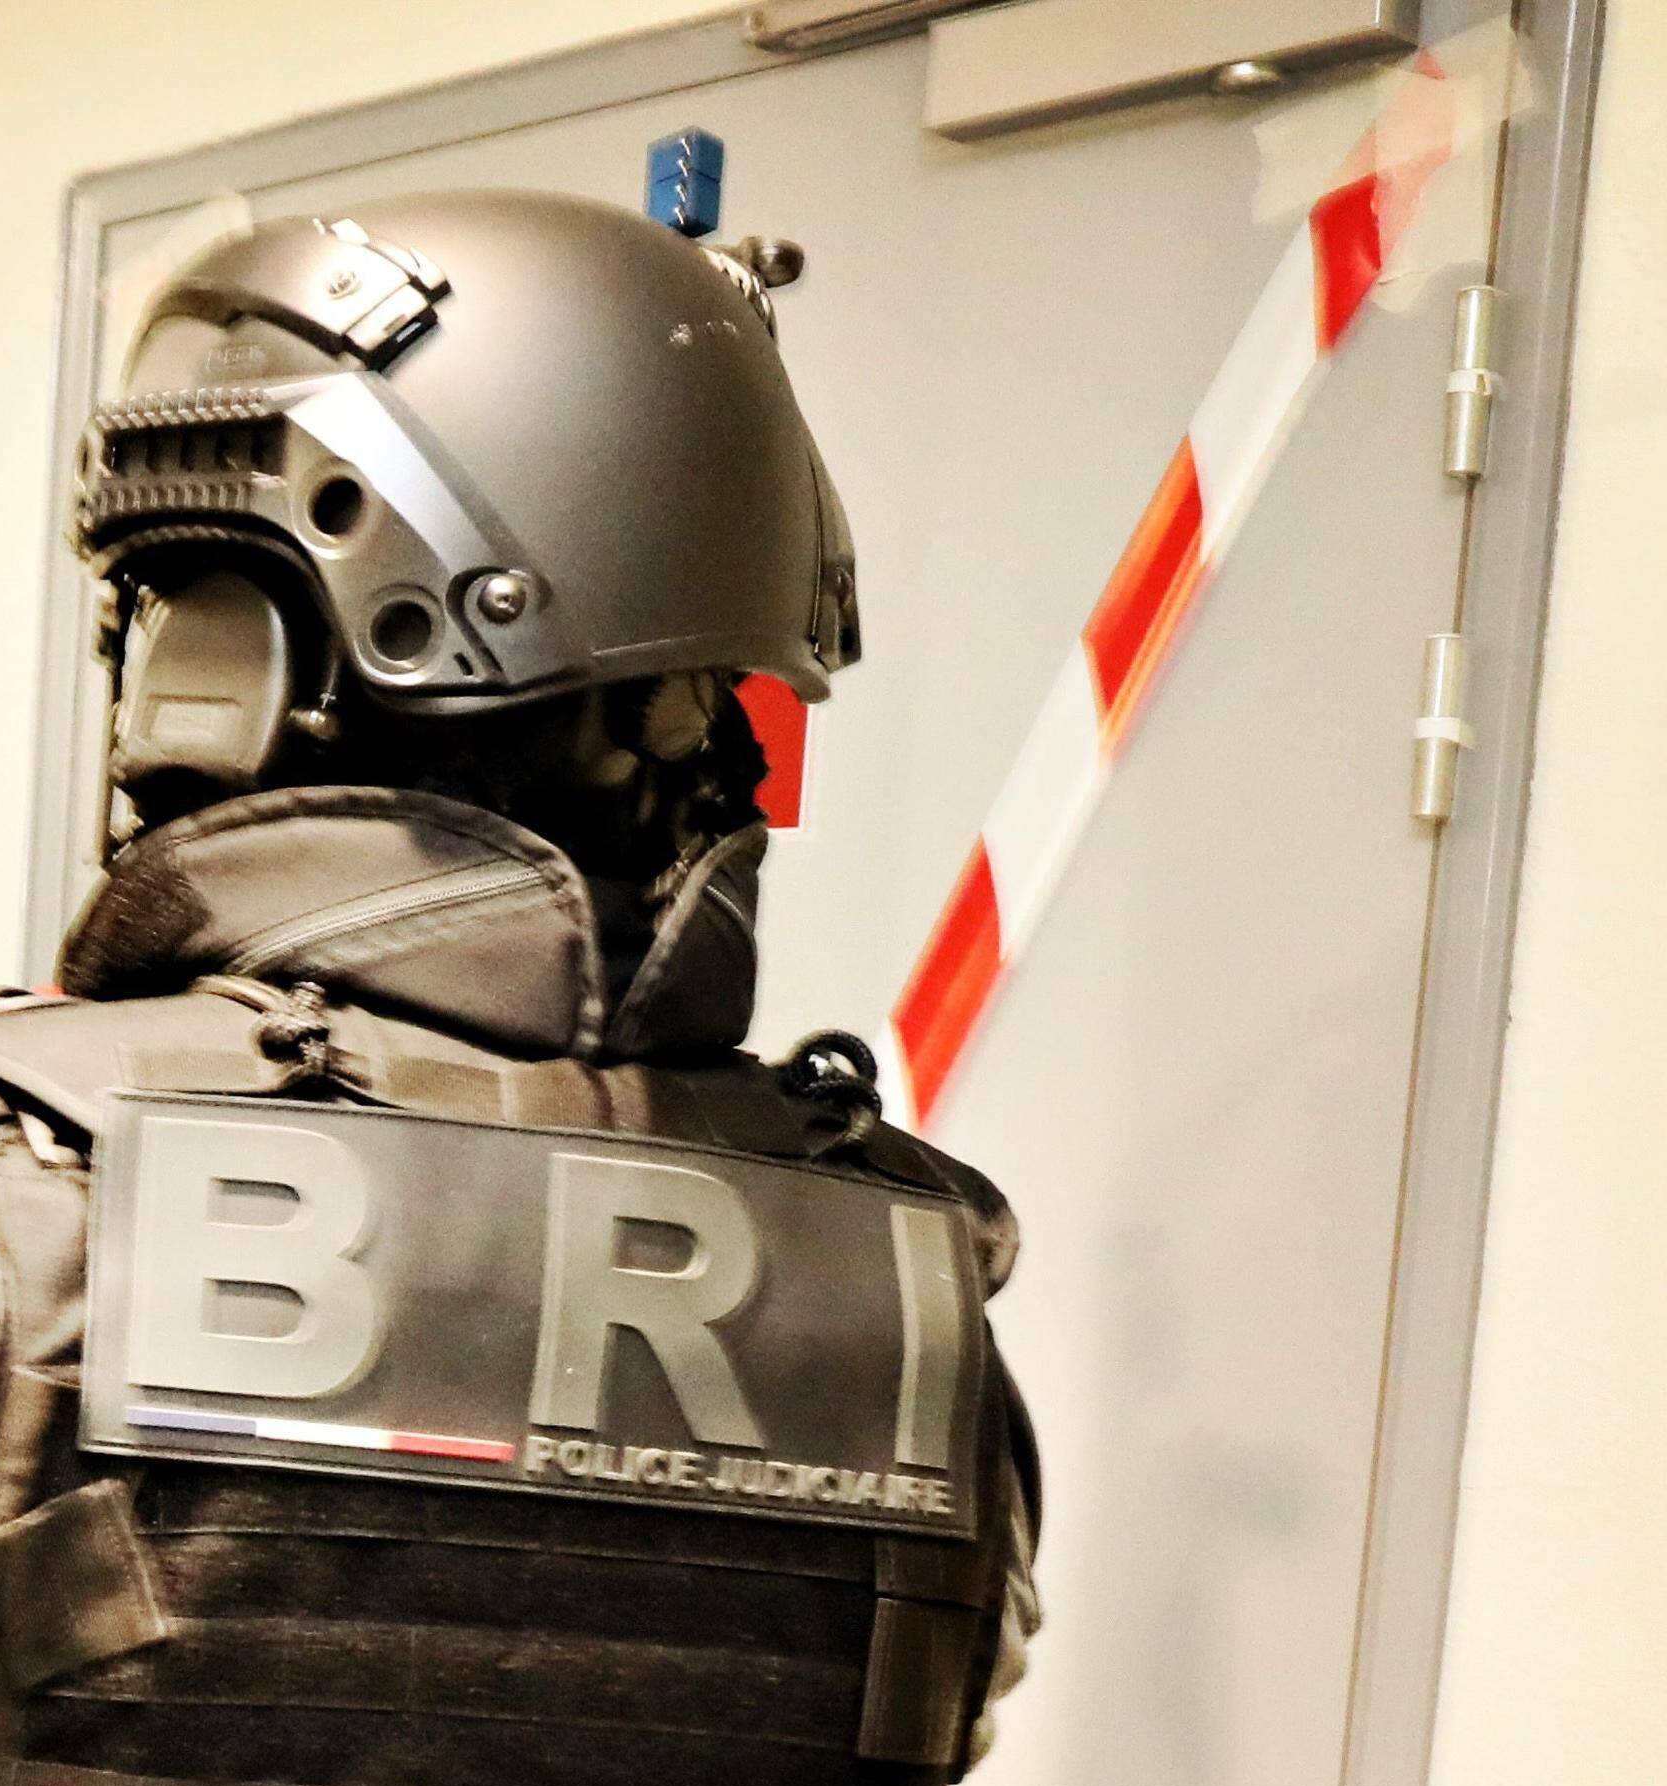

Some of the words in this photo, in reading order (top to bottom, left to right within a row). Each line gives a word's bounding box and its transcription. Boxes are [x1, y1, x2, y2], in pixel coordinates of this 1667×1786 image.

[126, 1117, 959, 1467] BRI
[525, 1435, 705, 1489] POLICE
[705, 1456, 955, 1514] JUDICIAIRE
